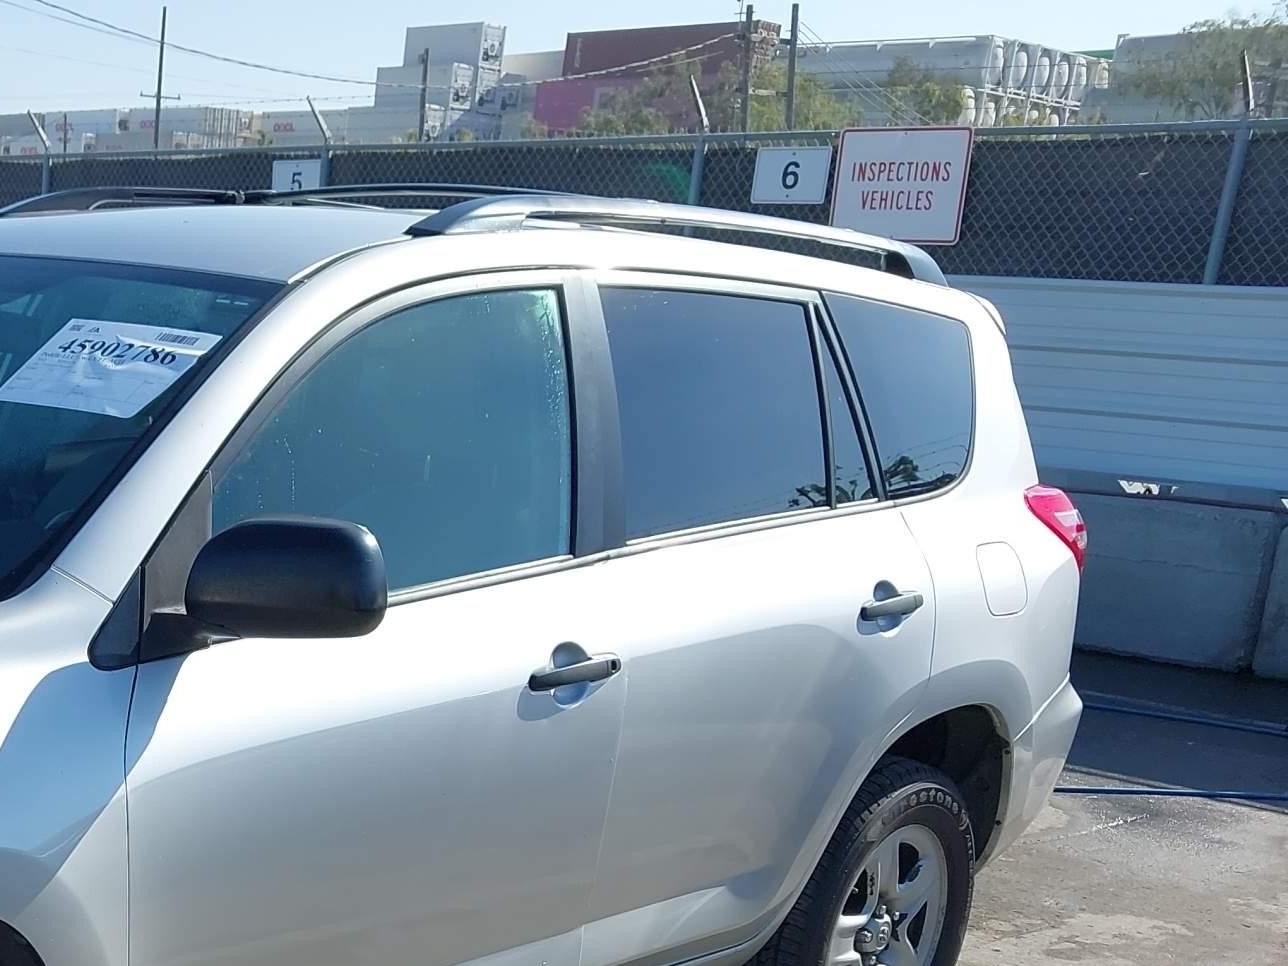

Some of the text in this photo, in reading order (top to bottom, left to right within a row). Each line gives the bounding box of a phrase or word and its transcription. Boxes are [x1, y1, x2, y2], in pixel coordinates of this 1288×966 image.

[290, 172, 302, 190] 5
[781, 161, 801, 190] 6
[851, 161, 952, 183] INSPECTIONS
[861, 190, 934, 211] VEHICLES
[58, 338, 177, 366] 45902786
